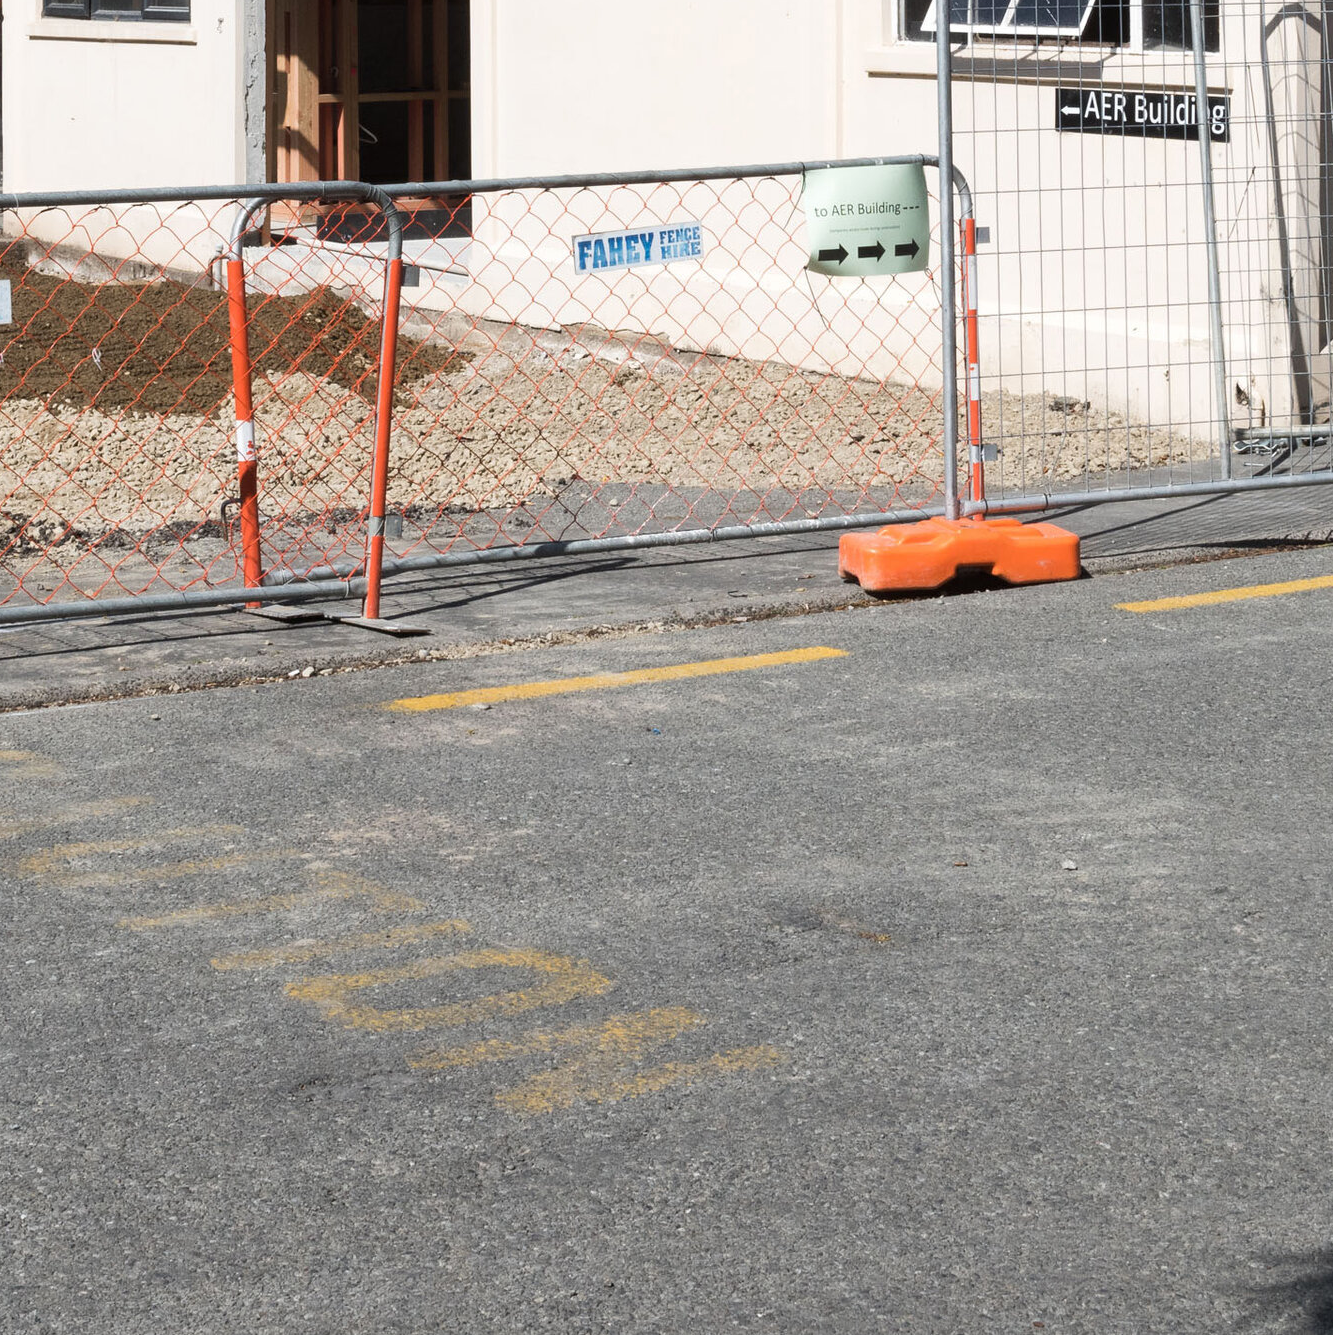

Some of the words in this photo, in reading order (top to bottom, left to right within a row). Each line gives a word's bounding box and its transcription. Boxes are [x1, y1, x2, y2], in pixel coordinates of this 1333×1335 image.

[1084, 90, 1128, 123] AER
[1133, 93, 1226, 135] Buildig
[814, 207, 828, 218] to
[831, 204, 855, 217] AER
[858, 201, 901, 216] Building
[577, 231, 654, 270] FAHEY
[659, 226, 700, 245] FENCE
[661, 241, 701, 260] HIRE
